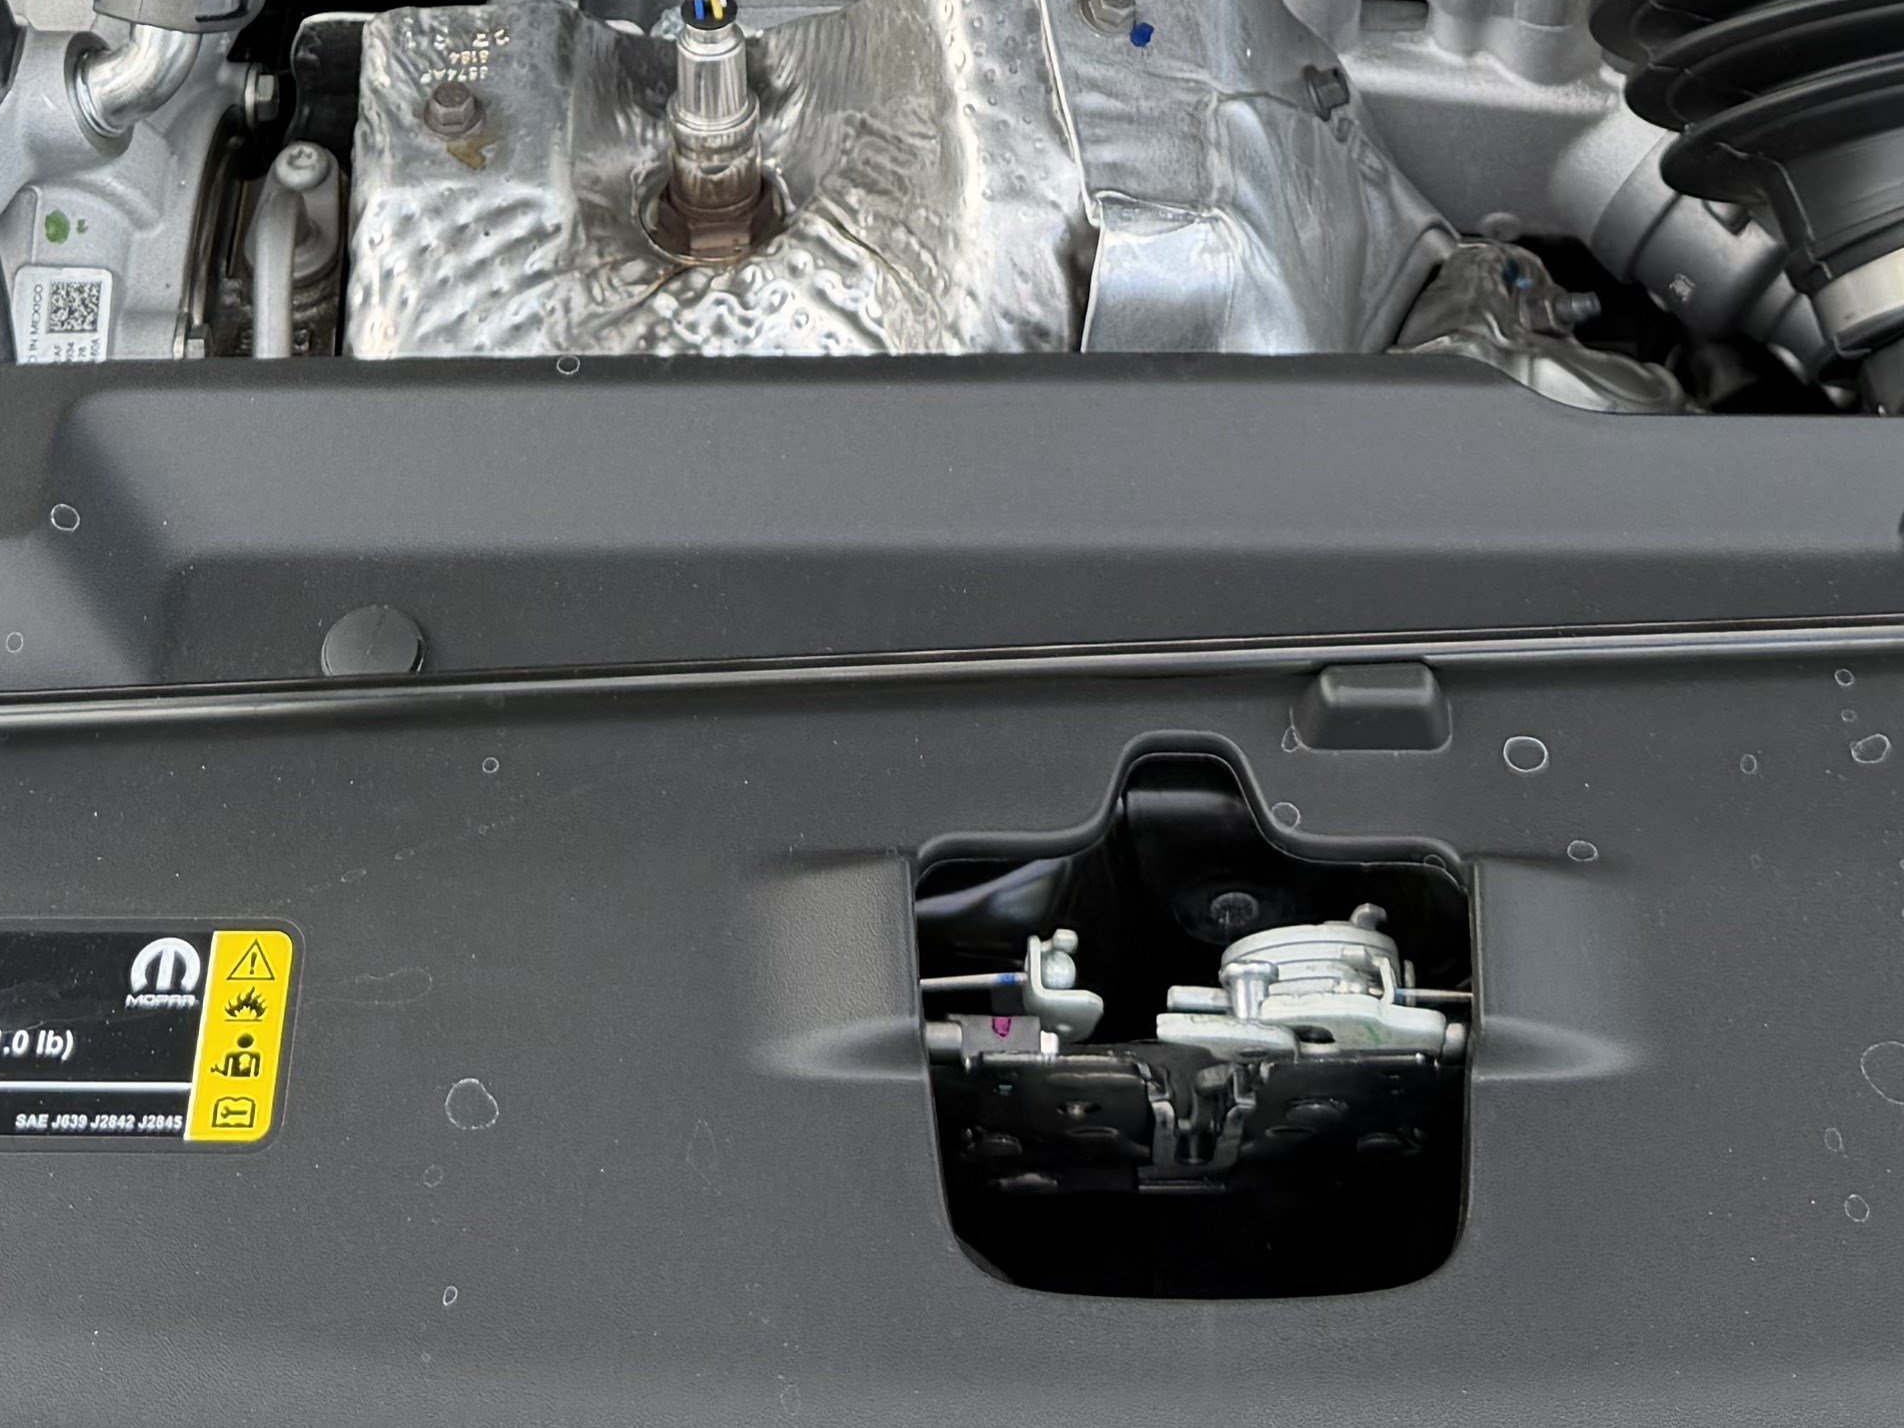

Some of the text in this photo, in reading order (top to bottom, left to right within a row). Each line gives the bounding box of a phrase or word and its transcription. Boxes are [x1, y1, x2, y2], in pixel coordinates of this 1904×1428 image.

[29, 283, 44, 335] MEXICO
[125, 994, 200, 1008] MOPAR
[36, 1030, 76, 1060] lb)
[15, 1113, 183, 1131] SAE J639 J2842 J2845
